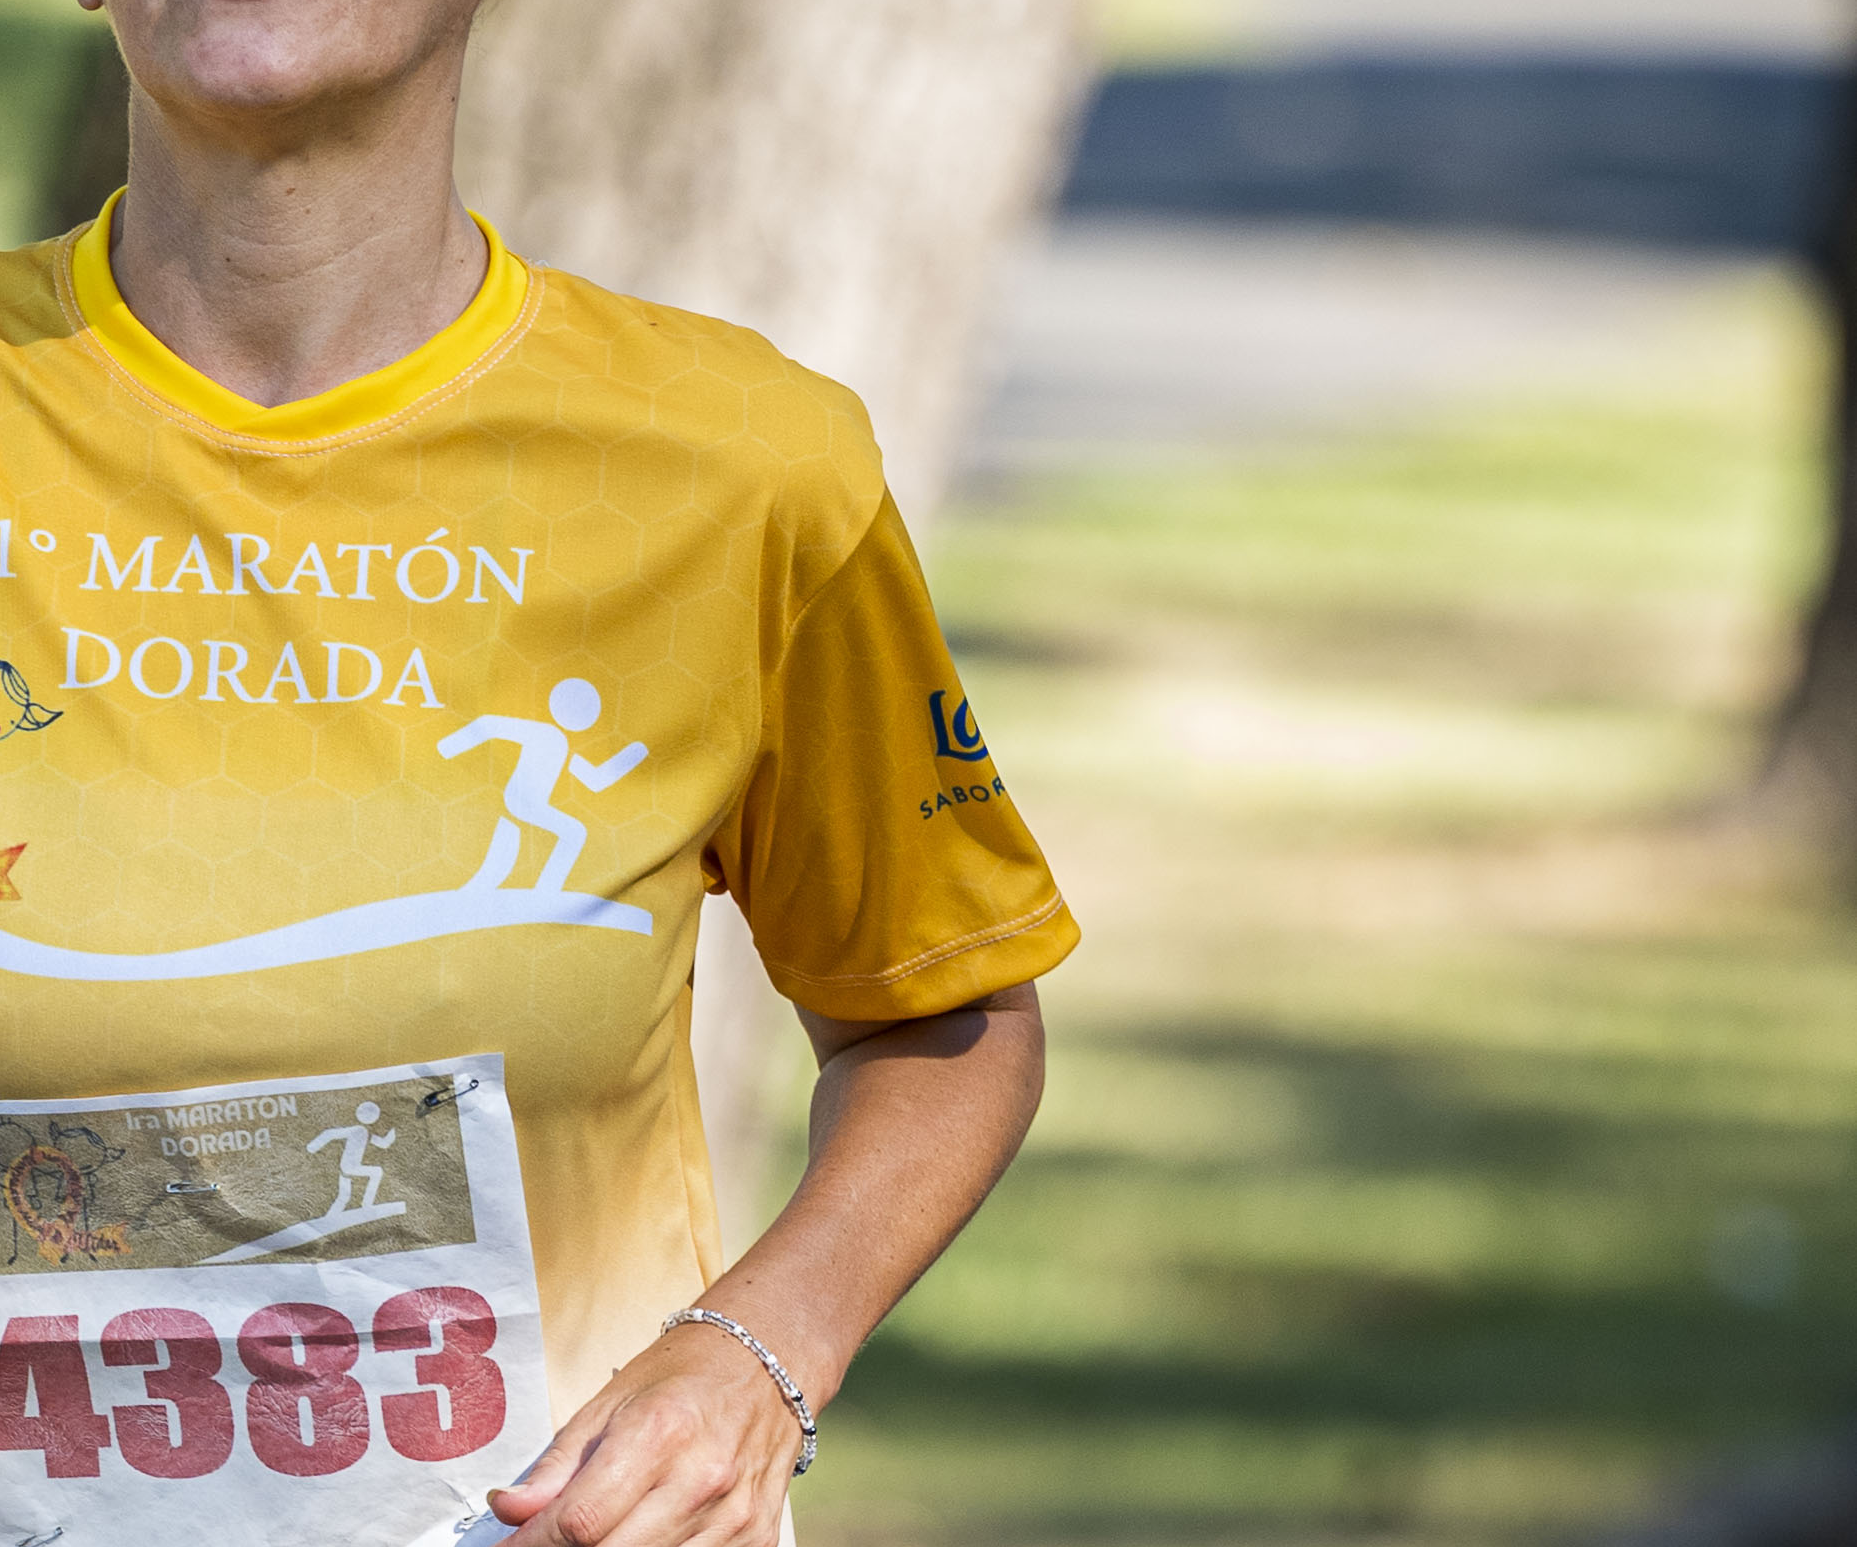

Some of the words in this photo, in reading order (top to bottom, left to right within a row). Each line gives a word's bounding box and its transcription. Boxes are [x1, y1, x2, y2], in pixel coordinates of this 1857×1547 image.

[79, 527, 535, 605] MARATÓN
[58, 627, 445, 709] DORADA
[164, 1095, 299, 1131] MARATON
[160, 1127, 272, 1158] DORADA
